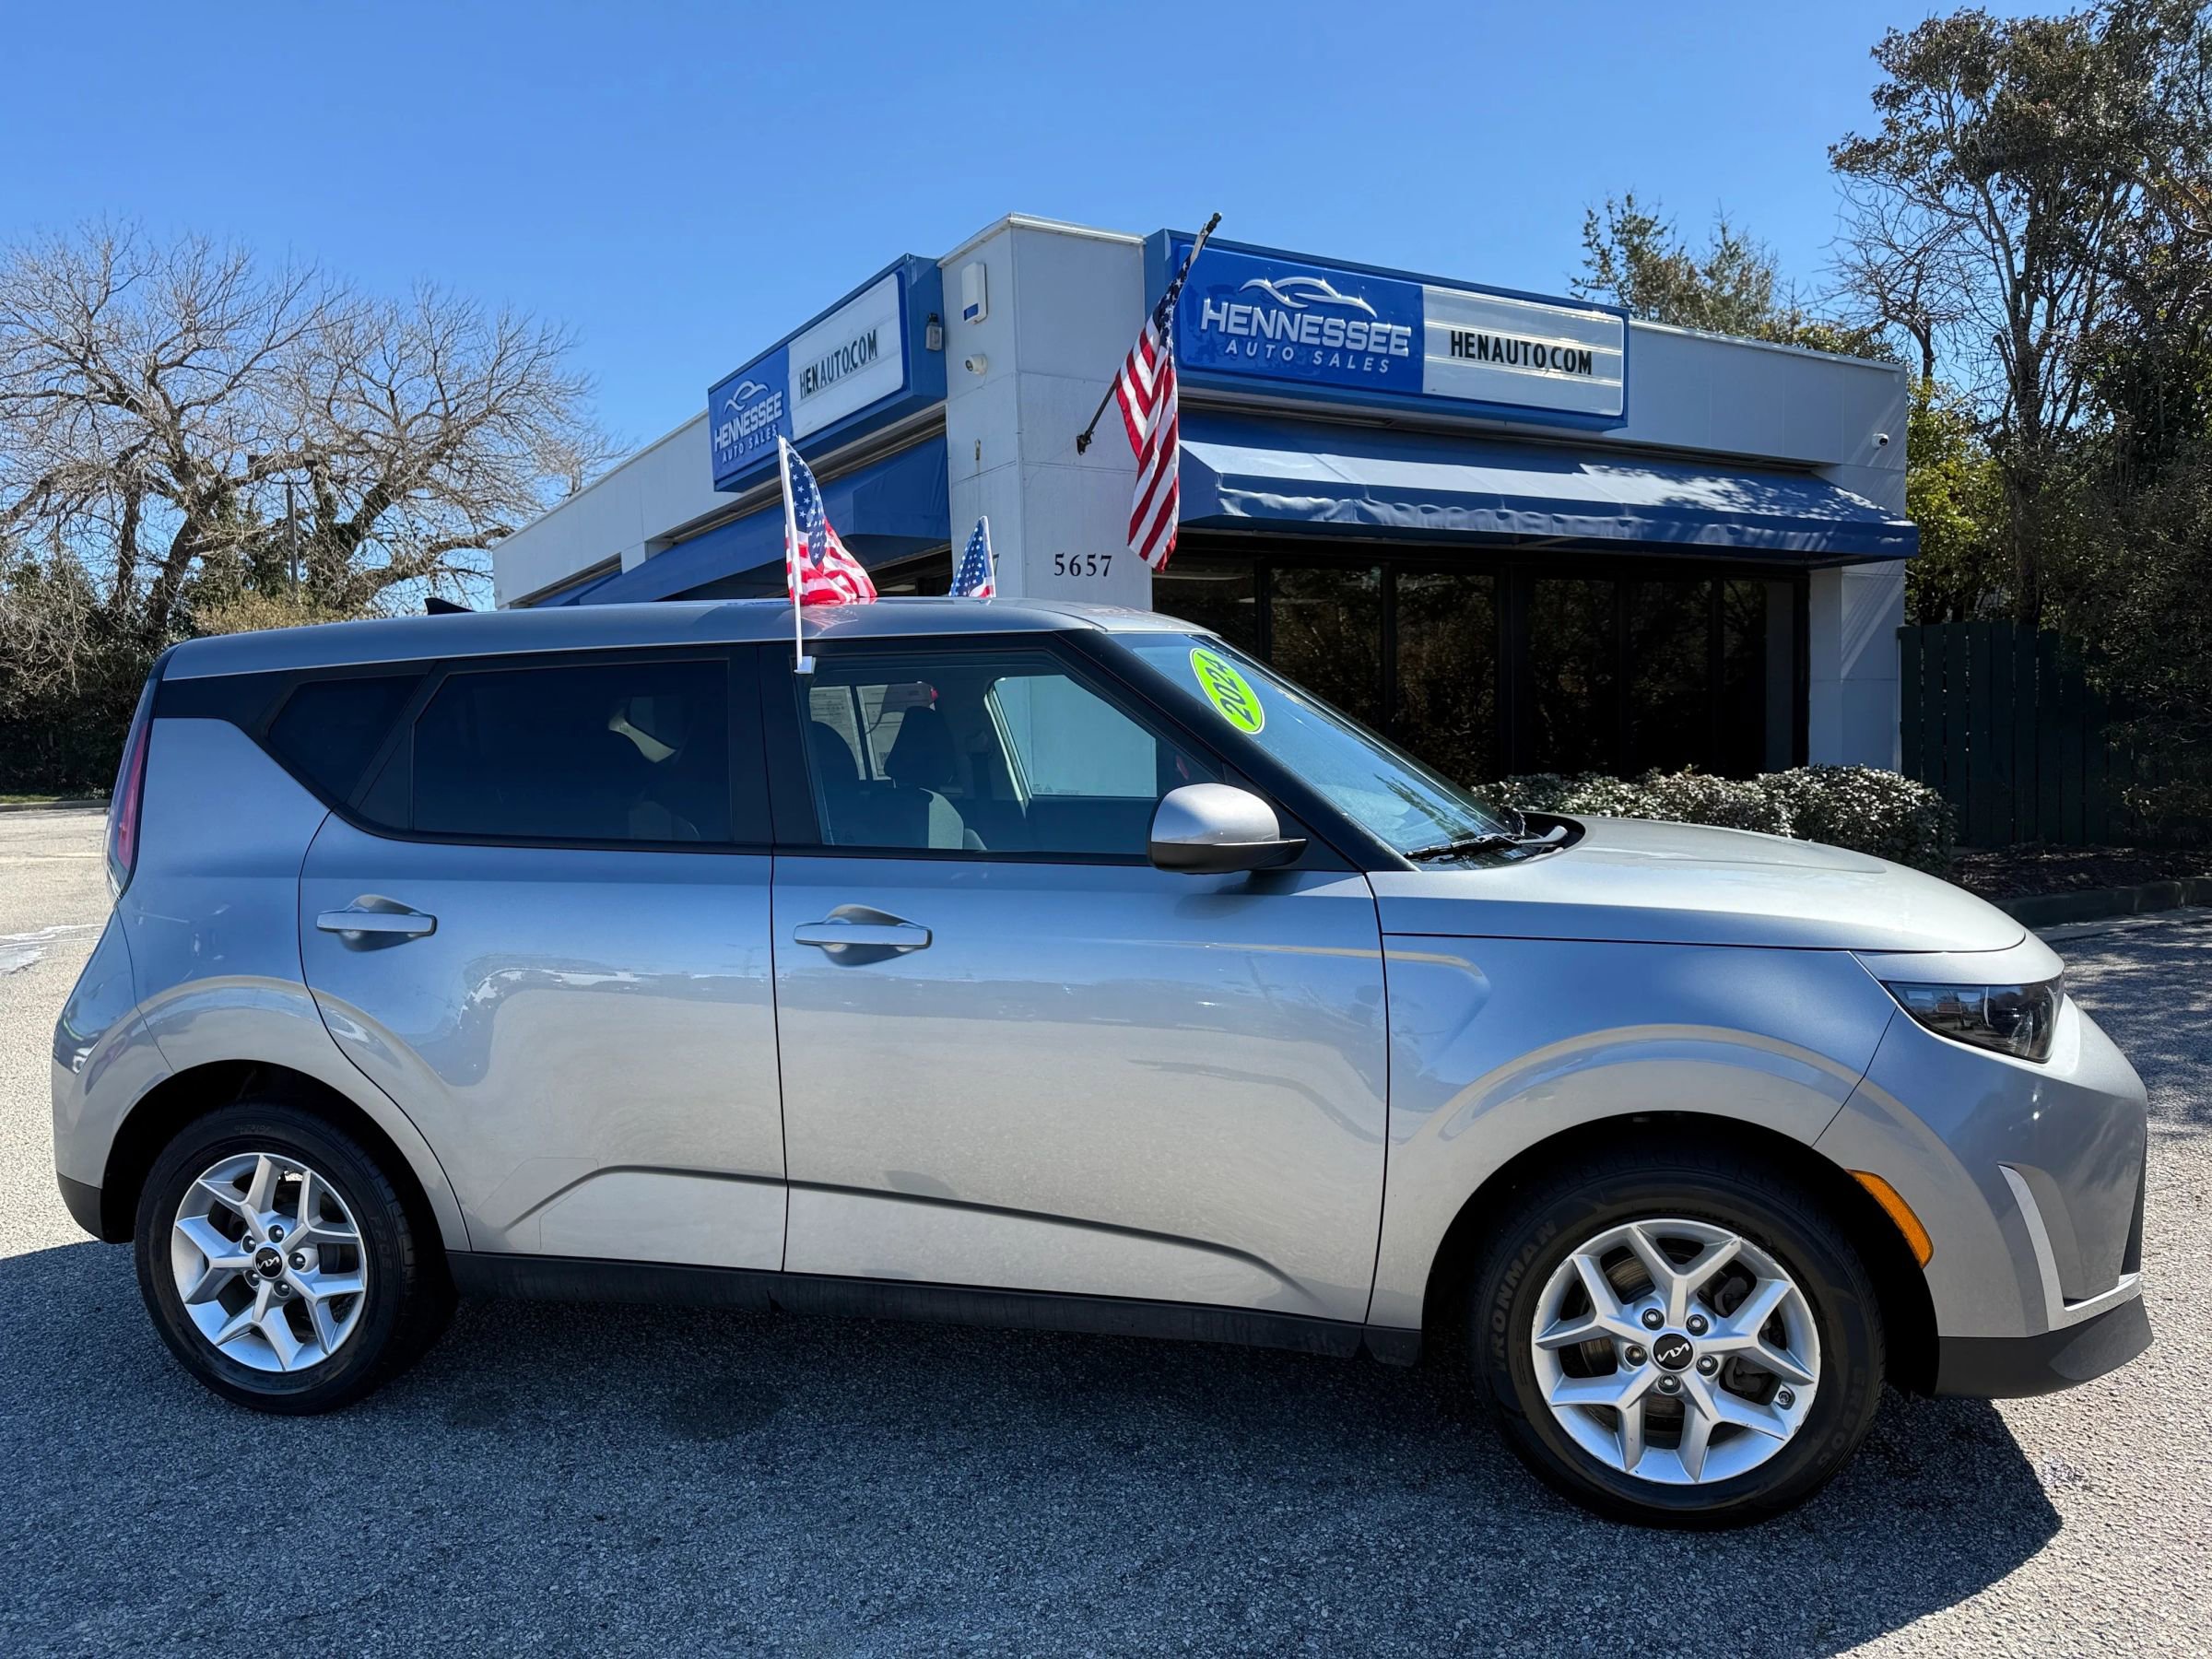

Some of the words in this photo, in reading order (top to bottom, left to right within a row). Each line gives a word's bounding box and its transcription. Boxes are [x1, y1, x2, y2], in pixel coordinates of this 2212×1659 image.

[1200, 298, 1412, 358] HENNESSEE
[1225, 338, 1294, 362] AUTO
[1312, 350, 1390, 374] SALES
[714, 390, 783, 453] HENNESSEE
[722, 443, 745, 464] AUTO
[748, 423, 778, 451] SALES
[1053, 553, 1112, 577] 5657
[1195, 652, 1256, 727] 2024
[1490, 1219, 1558, 1372] IRONMAN
